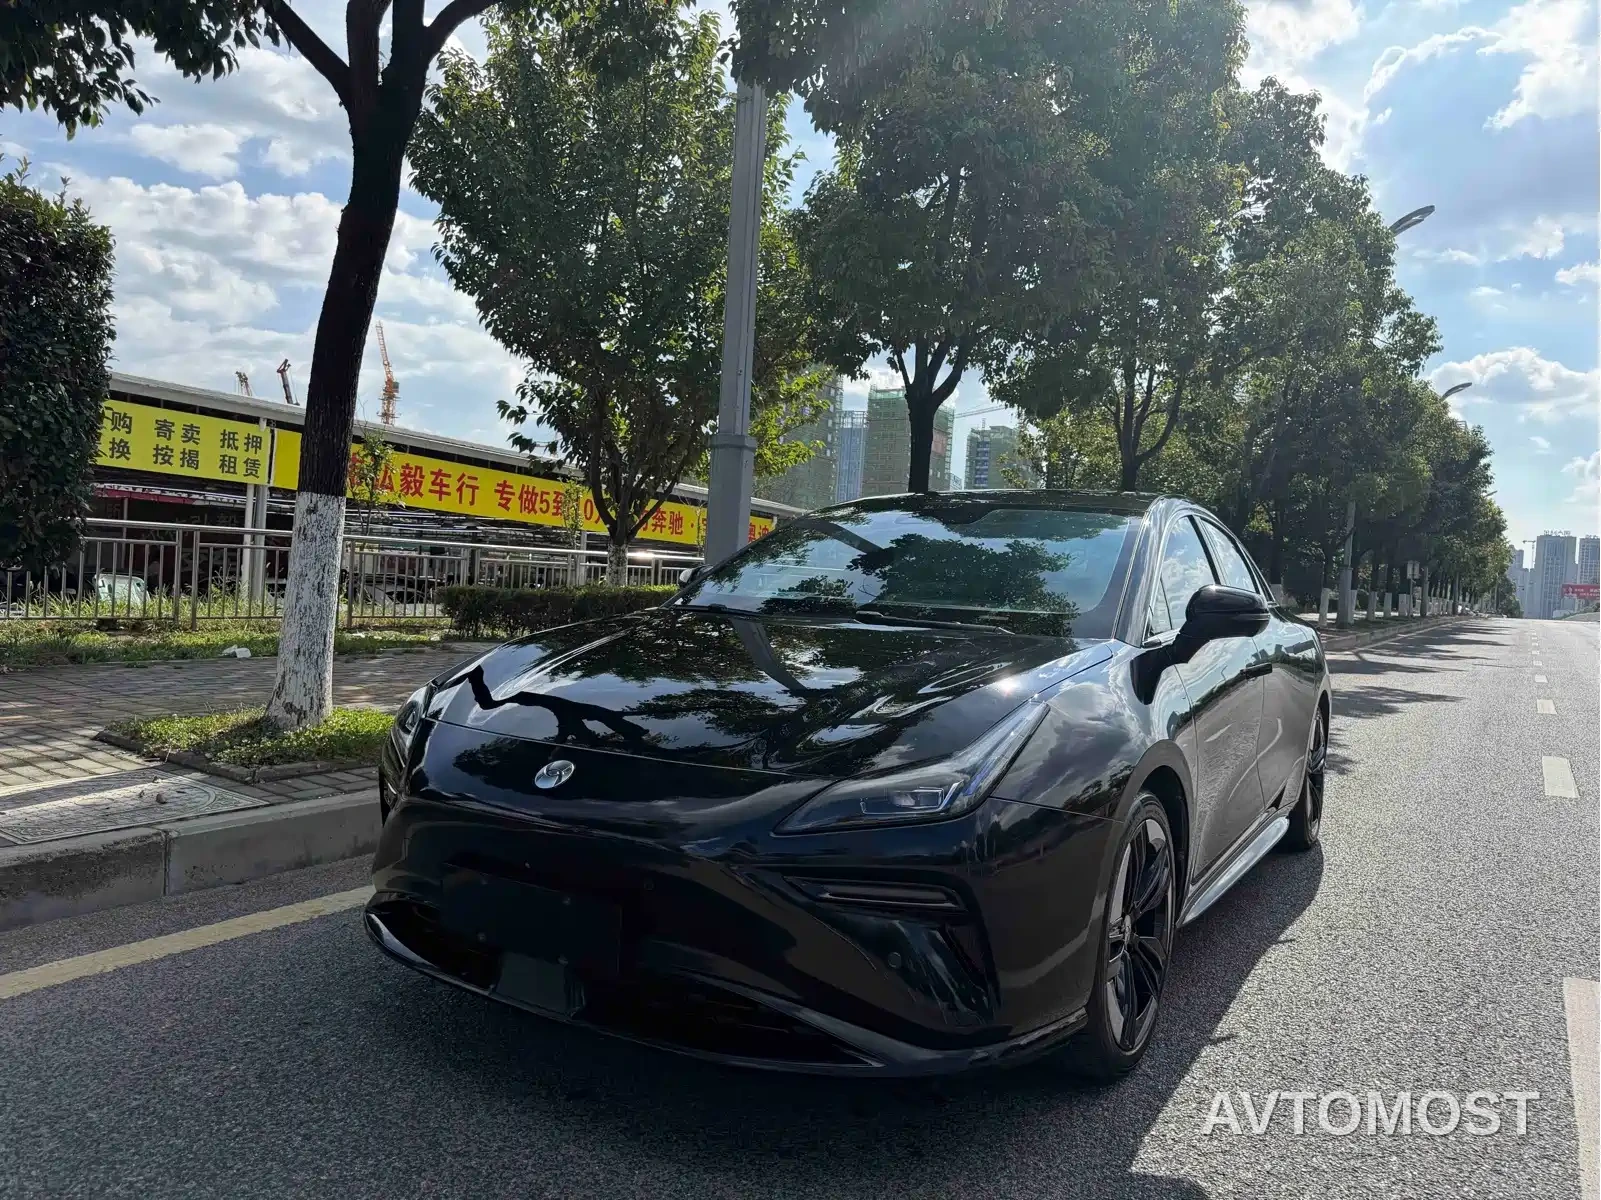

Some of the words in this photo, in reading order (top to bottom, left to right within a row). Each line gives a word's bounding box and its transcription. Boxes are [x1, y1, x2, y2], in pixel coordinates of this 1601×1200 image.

[153, 418, 201, 446] 寄卖
[219, 428, 263, 455] 抵押
[152, 444, 200, 471] 按揭
[218, 454, 262, 479] 租赁
